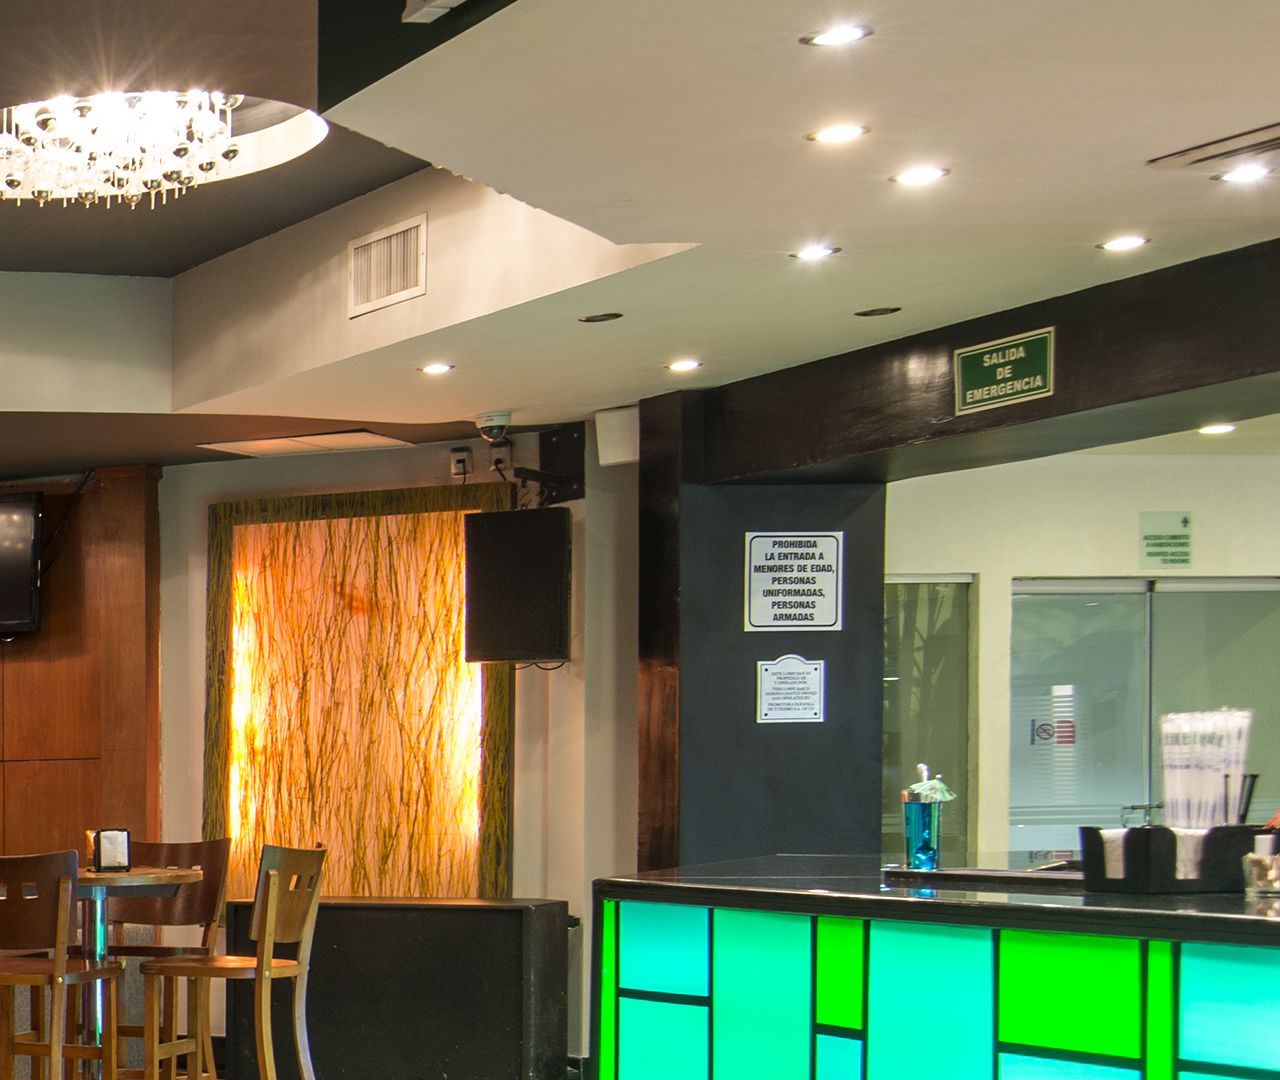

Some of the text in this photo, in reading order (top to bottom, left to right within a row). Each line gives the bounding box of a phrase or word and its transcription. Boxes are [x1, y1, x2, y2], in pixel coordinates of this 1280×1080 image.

[983, 346, 1026, 367] SALIDA
[996, 365, 1013, 380] DE
[966, 375, 1042, 403] EMERGENCIA
[772, 540, 818, 549] PROHIBIDA
[765, 552, 824, 561] LA ENTRADA A
[753, 565, 835, 574] MENORES DE EDAD,
[771, 577, 817, 585] PERSONAS
[763, 589, 826, 598] UNIFORMADAS,
[771, 601, 816, 609] PERSONAS
[772, 613, 815, 621] ARMADAS
